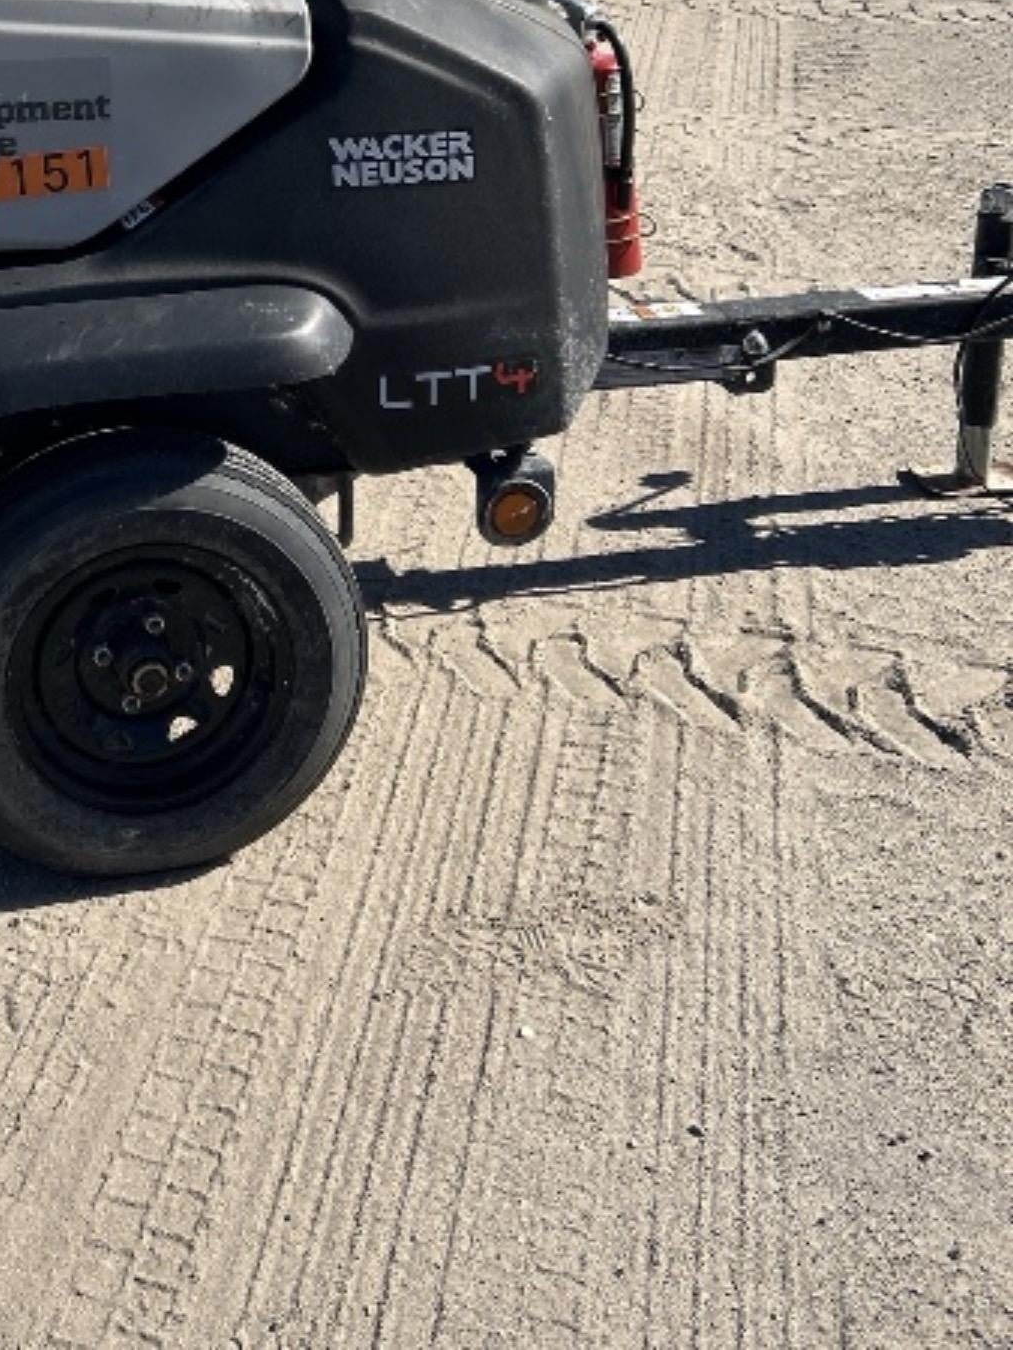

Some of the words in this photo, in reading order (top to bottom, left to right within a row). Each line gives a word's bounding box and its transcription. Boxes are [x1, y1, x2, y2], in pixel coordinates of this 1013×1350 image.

[328, 130, 474, 163] WACKER
[330, 155, 475, 188] NEUSON
[379, 360, 537, 409] LTT4
